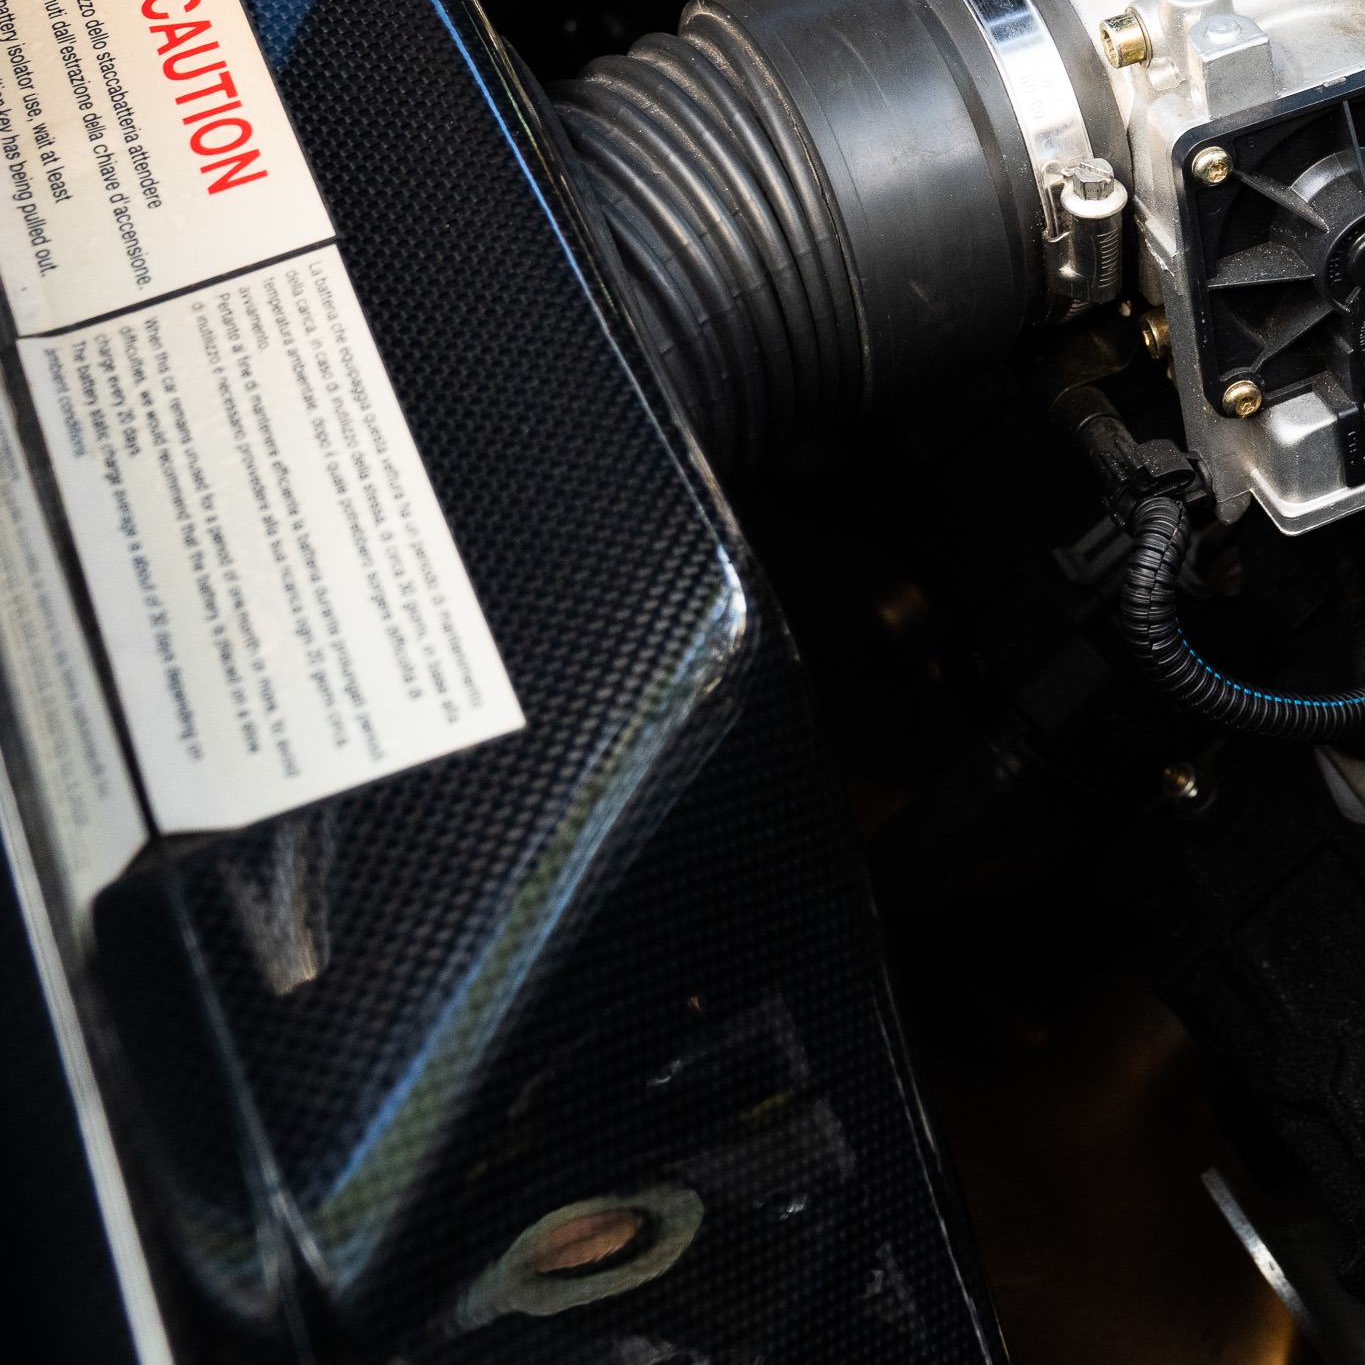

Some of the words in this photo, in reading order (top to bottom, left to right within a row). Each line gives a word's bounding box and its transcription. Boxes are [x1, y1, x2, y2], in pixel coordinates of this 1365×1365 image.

[84, 18, 110, 50] dello
[5, 41, 35, 90] isolator
[50, 20, 94, 111] dall'estrazione
[21, 92, 42, 122] use,
[95, 50, 141, 144] staccabatteria
[0, 133, 21, 160] has
[31, 121, 56, 150] wait
[81, 112, 106, 142] della
[39, 149, 61, 167] at
[92, 143, 120, 191] chiave
[127, 144, 162, 209] attendere
[7, 159, 33, 201] being
[45, 165, 73, 204] least
[15, 202, 52, 247] pulled
[108, 192, 154, 289] d'accensione.
[33, 248, 60, 278] out.
